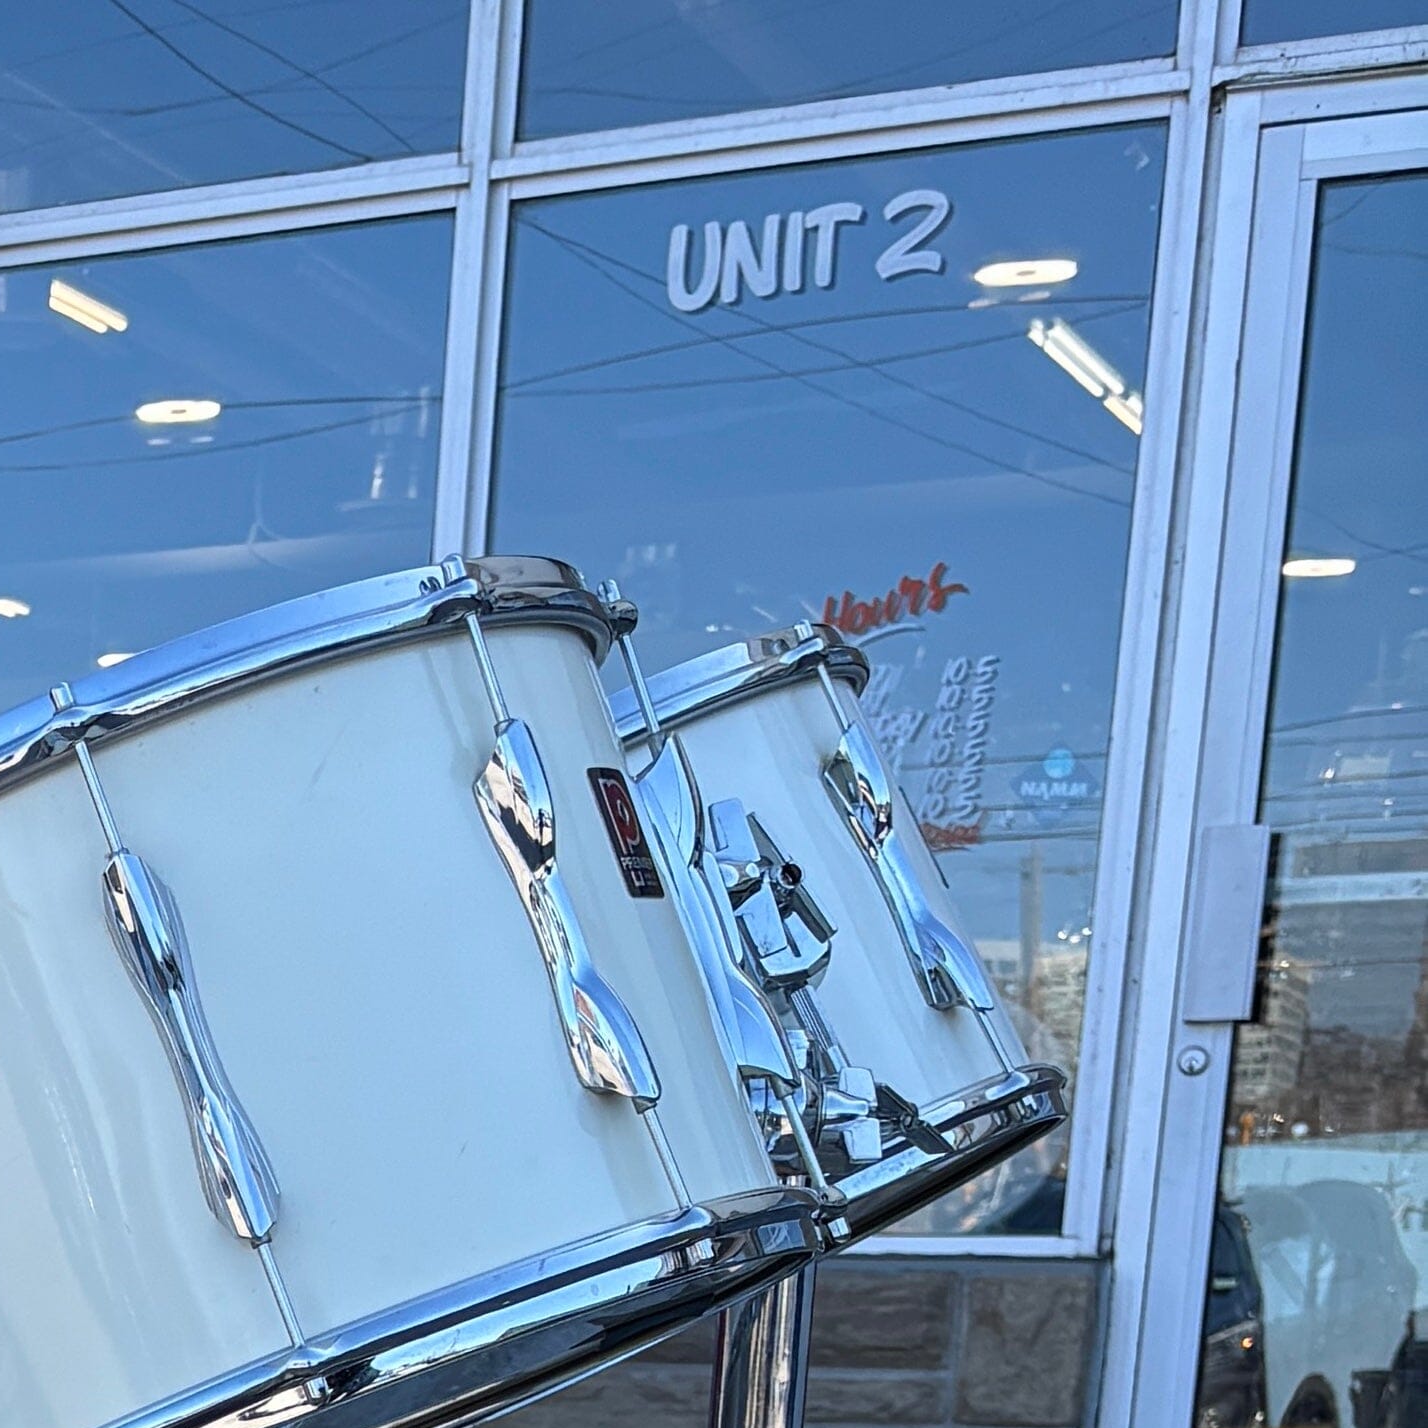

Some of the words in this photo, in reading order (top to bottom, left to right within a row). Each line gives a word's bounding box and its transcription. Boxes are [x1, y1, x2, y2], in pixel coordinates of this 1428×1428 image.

[667, 202, 863, 312] UNIT
[875, 189, 950, 280] 2
[823, 562, 969, 635] Hours
[1019, 780, 1089, 799] NAMM
